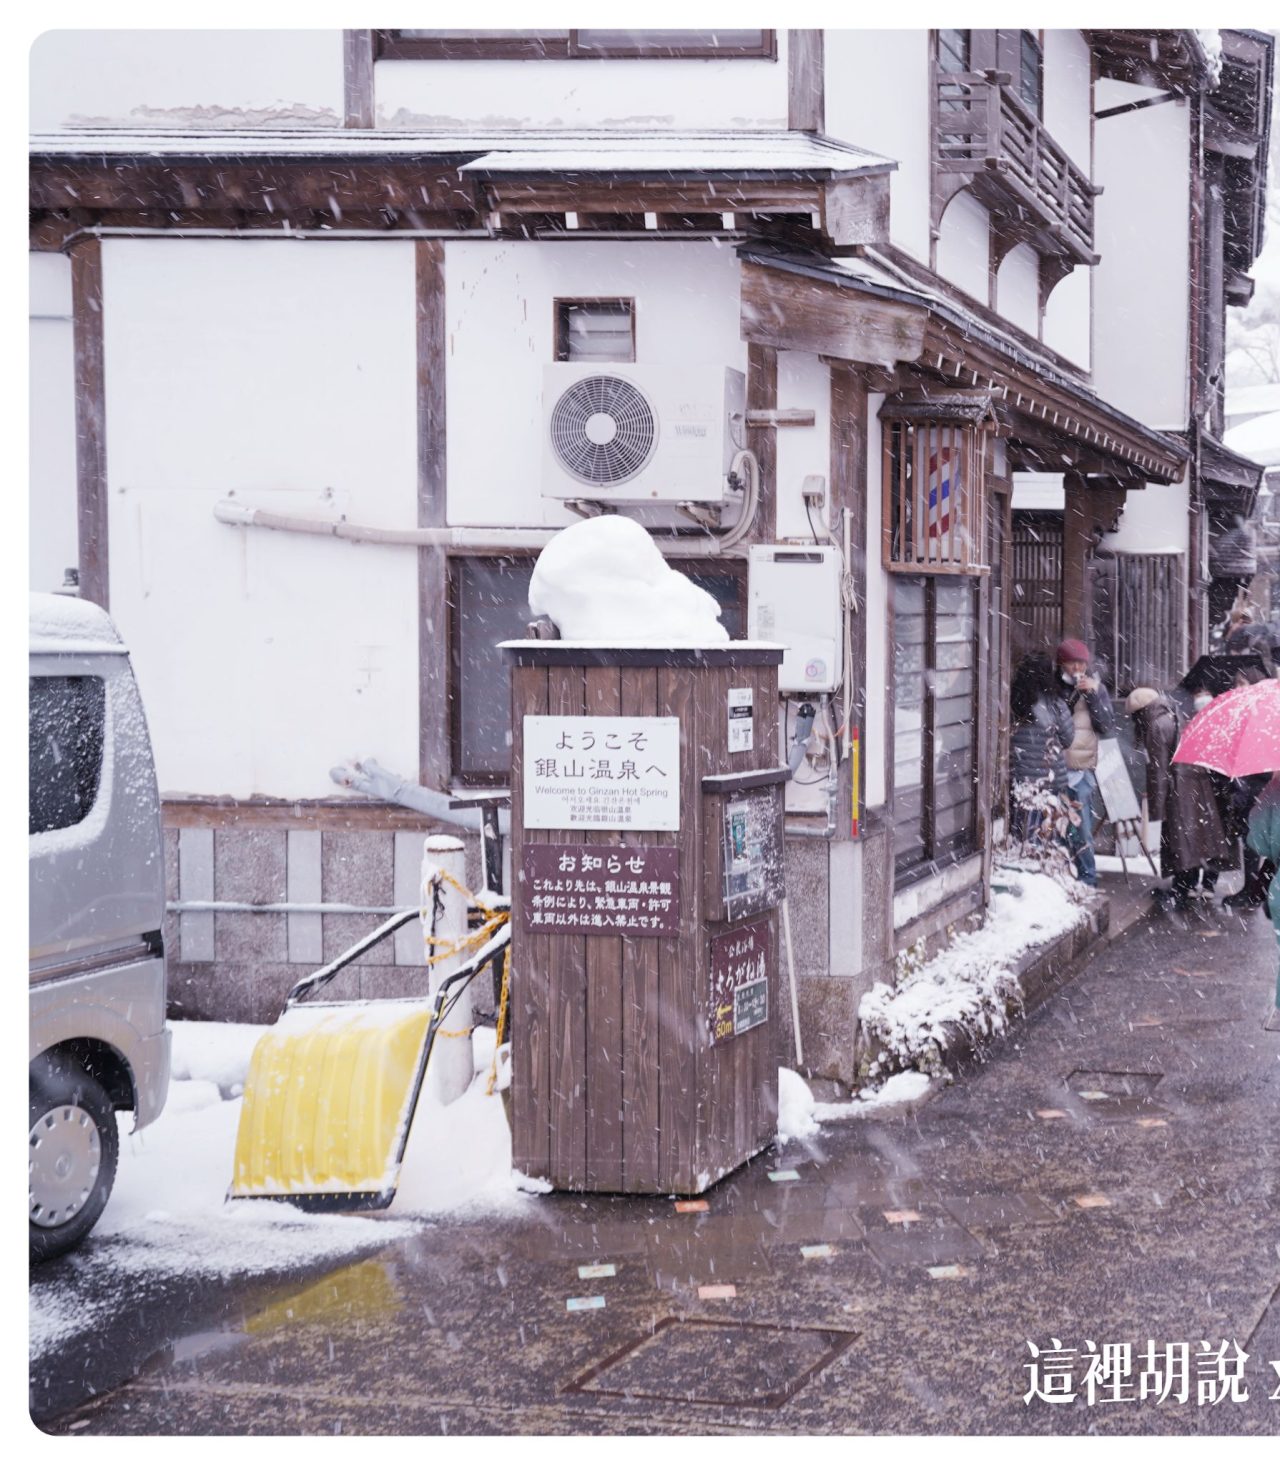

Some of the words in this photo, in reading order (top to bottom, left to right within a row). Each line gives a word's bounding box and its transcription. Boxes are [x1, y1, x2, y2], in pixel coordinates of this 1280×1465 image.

[556, 731, 648, 751] ようこそ
[534, 758, 667, 779] 銀山温泉へ
[535, 786, 576, 795] Welcome
[578, 787, 587, 795] to
[588, 787, 620, 796] Ginzan
[622, 788, 638, 796] Hot
[640, 788, 669, 799] Spring
[558, 853, 645, 874] お知らせ
[533, 879, 672, 895] これより先は、銀山温泉景観
[531, 912, 665, 929] 車両以外は進入禁止です。
